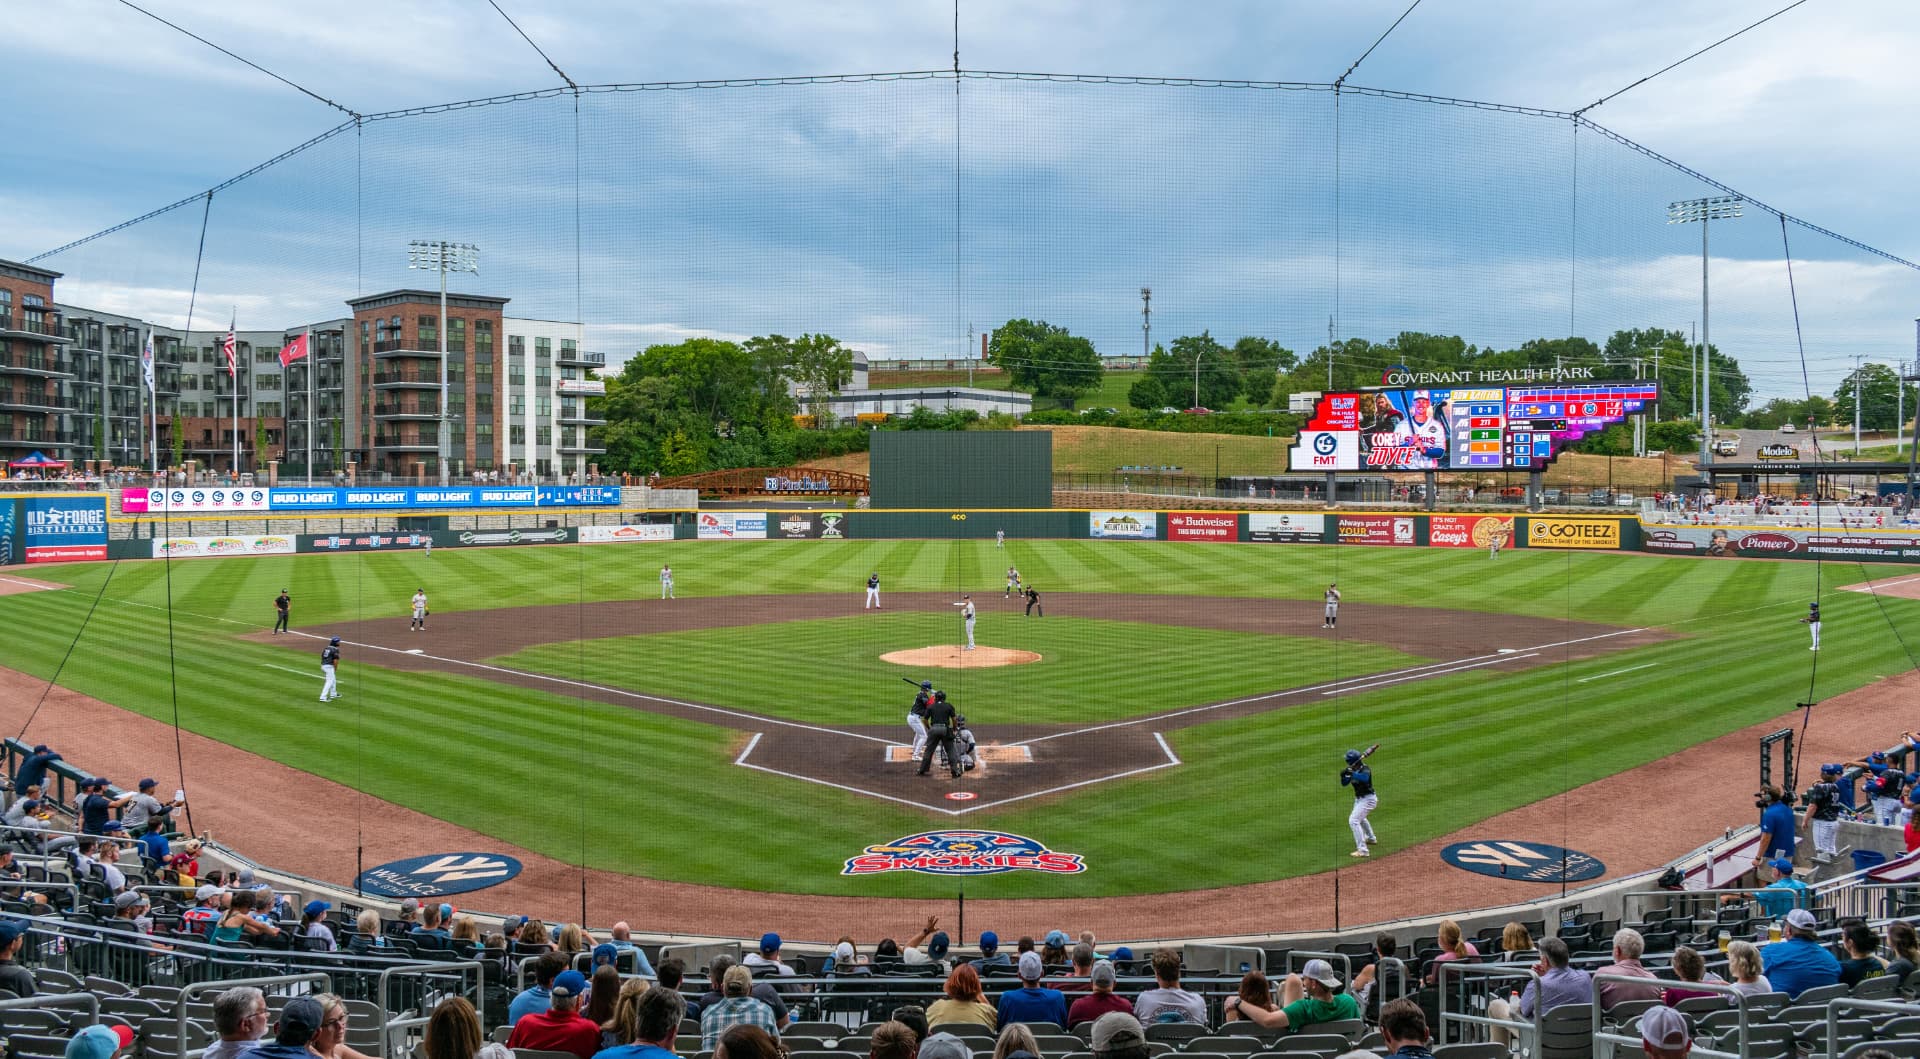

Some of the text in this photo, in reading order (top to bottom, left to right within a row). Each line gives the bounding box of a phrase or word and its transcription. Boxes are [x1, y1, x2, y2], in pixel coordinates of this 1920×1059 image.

[1388, 366, 1594, 385] COVENANT HEALTH PARK
[1549, 404, 1556, 415] 0
[1569, 404, 1577, 415] 0
[1371, 433, 1401, 447] COREY
[1367, 447, 1416, 466] JOYCE
[1762, 446, 1793, 456] Modelo
[1313, 455, 1337, 465] FMT
[273, 493, 335, 503] BUD LIGHT
[347, 493, 405, 502] BUD LIGHT
[416, 492, 471, 501] BUD LIGHT
[482, 492, 532, 501] BUD LIGHT
[27, 510, 105, 525] OLD FORGE
[1338, 519, 1365, 528] Always
[1365, 520, 1381, 528] part
[28, 525, 105, 534] DISTILLERY
[1339, 527, 1367, 535] YOUR
[1549, 523, 1612, 538] GOTEEZ
[1431, 530, 1468, 545] Casey's
[1746, 538, 1789, 550] Pioneer
[853, 853, 1080, 873] SMOKIES
[1522, 853, 1593, 880] WALLACE
[369, 868, 444, 896] WALLACE
